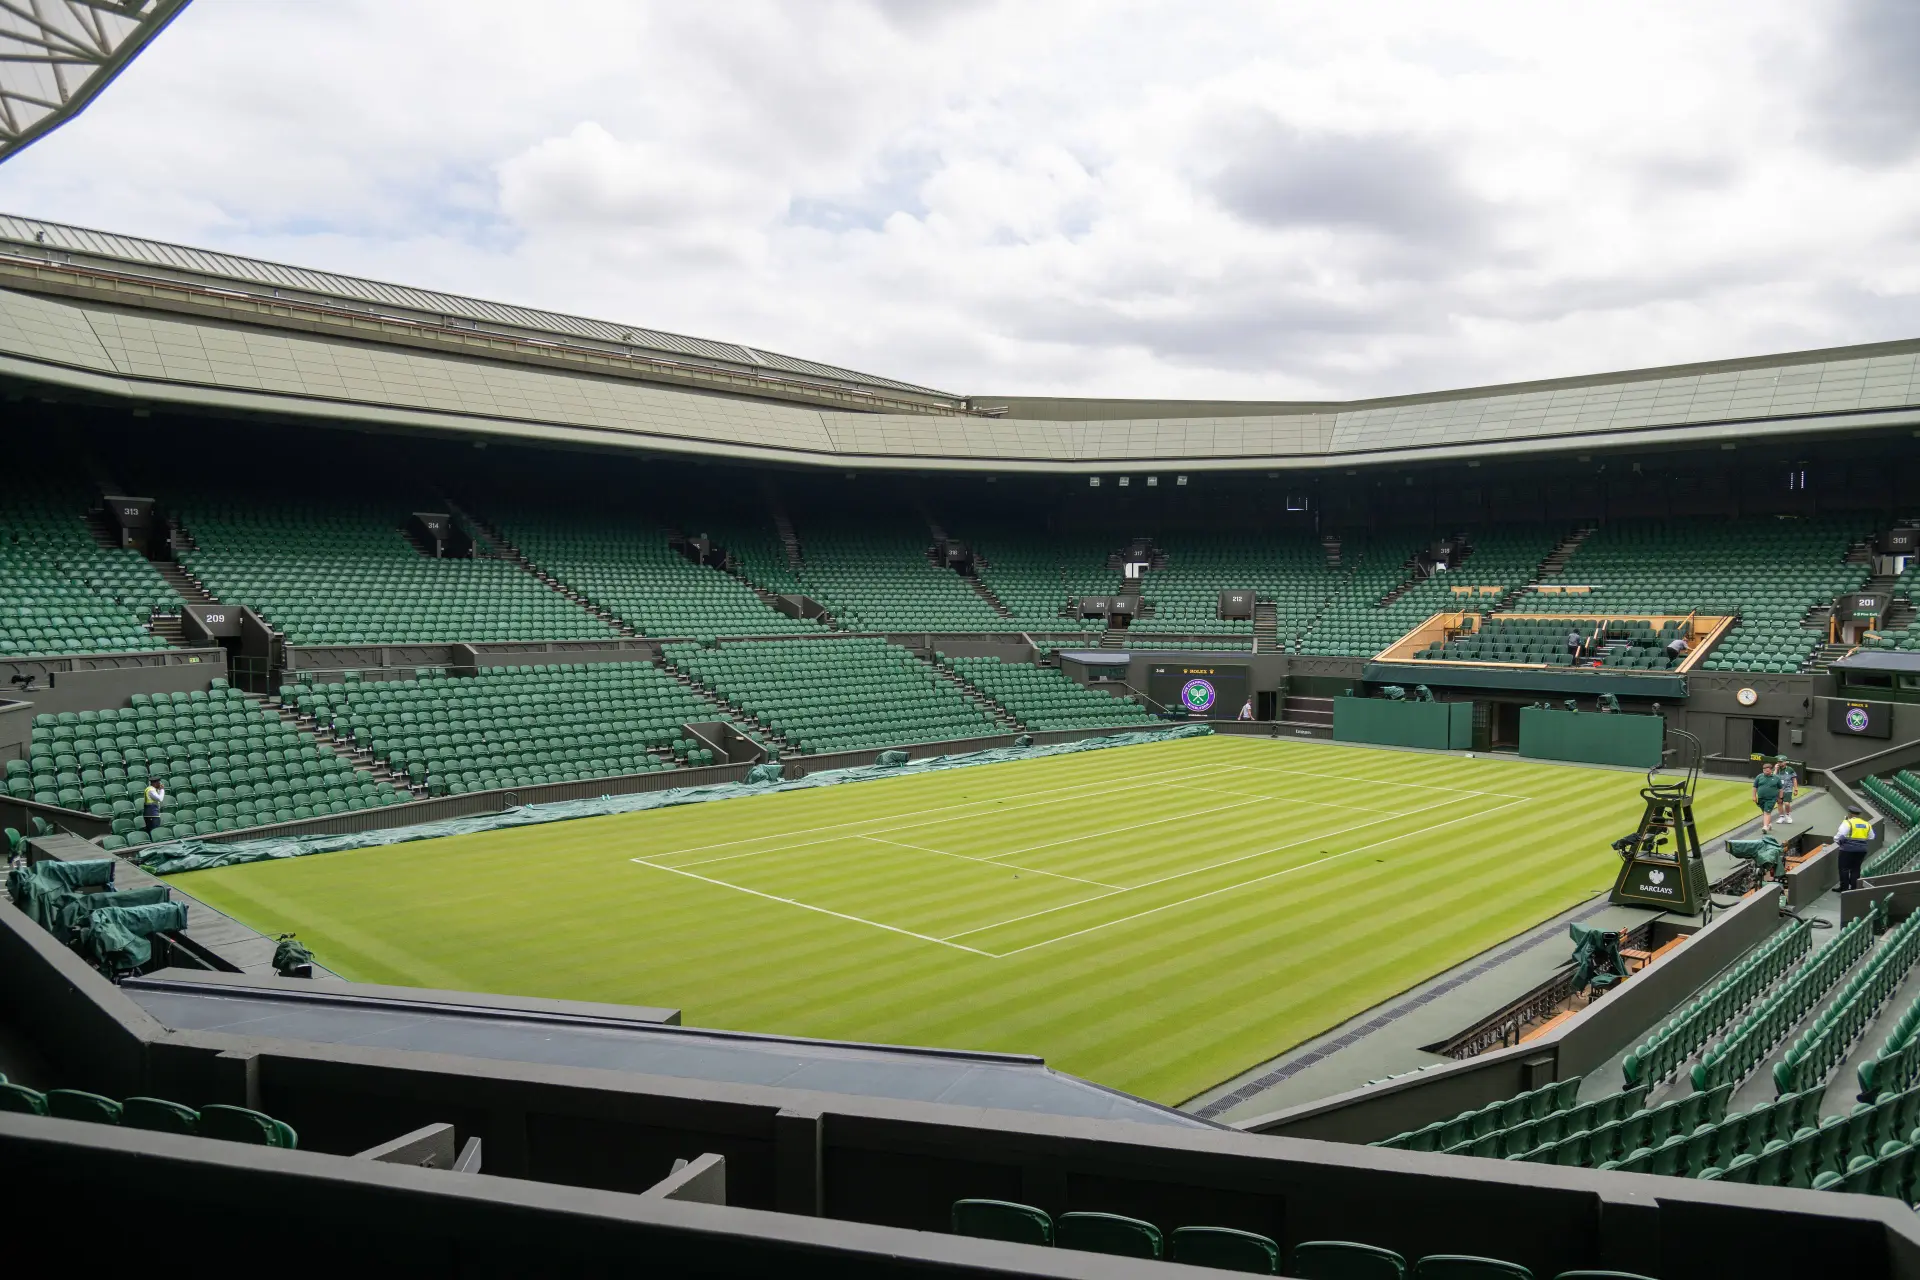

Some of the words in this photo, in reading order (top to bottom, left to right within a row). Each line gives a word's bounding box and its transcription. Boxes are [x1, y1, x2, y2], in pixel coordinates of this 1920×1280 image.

[124, 508, 139, 516] 313
[1858, 599, 1874, 607] 201
[206, 614, 225, 623] 209
[1639, 884, 1673, 895] BARCLAYS
